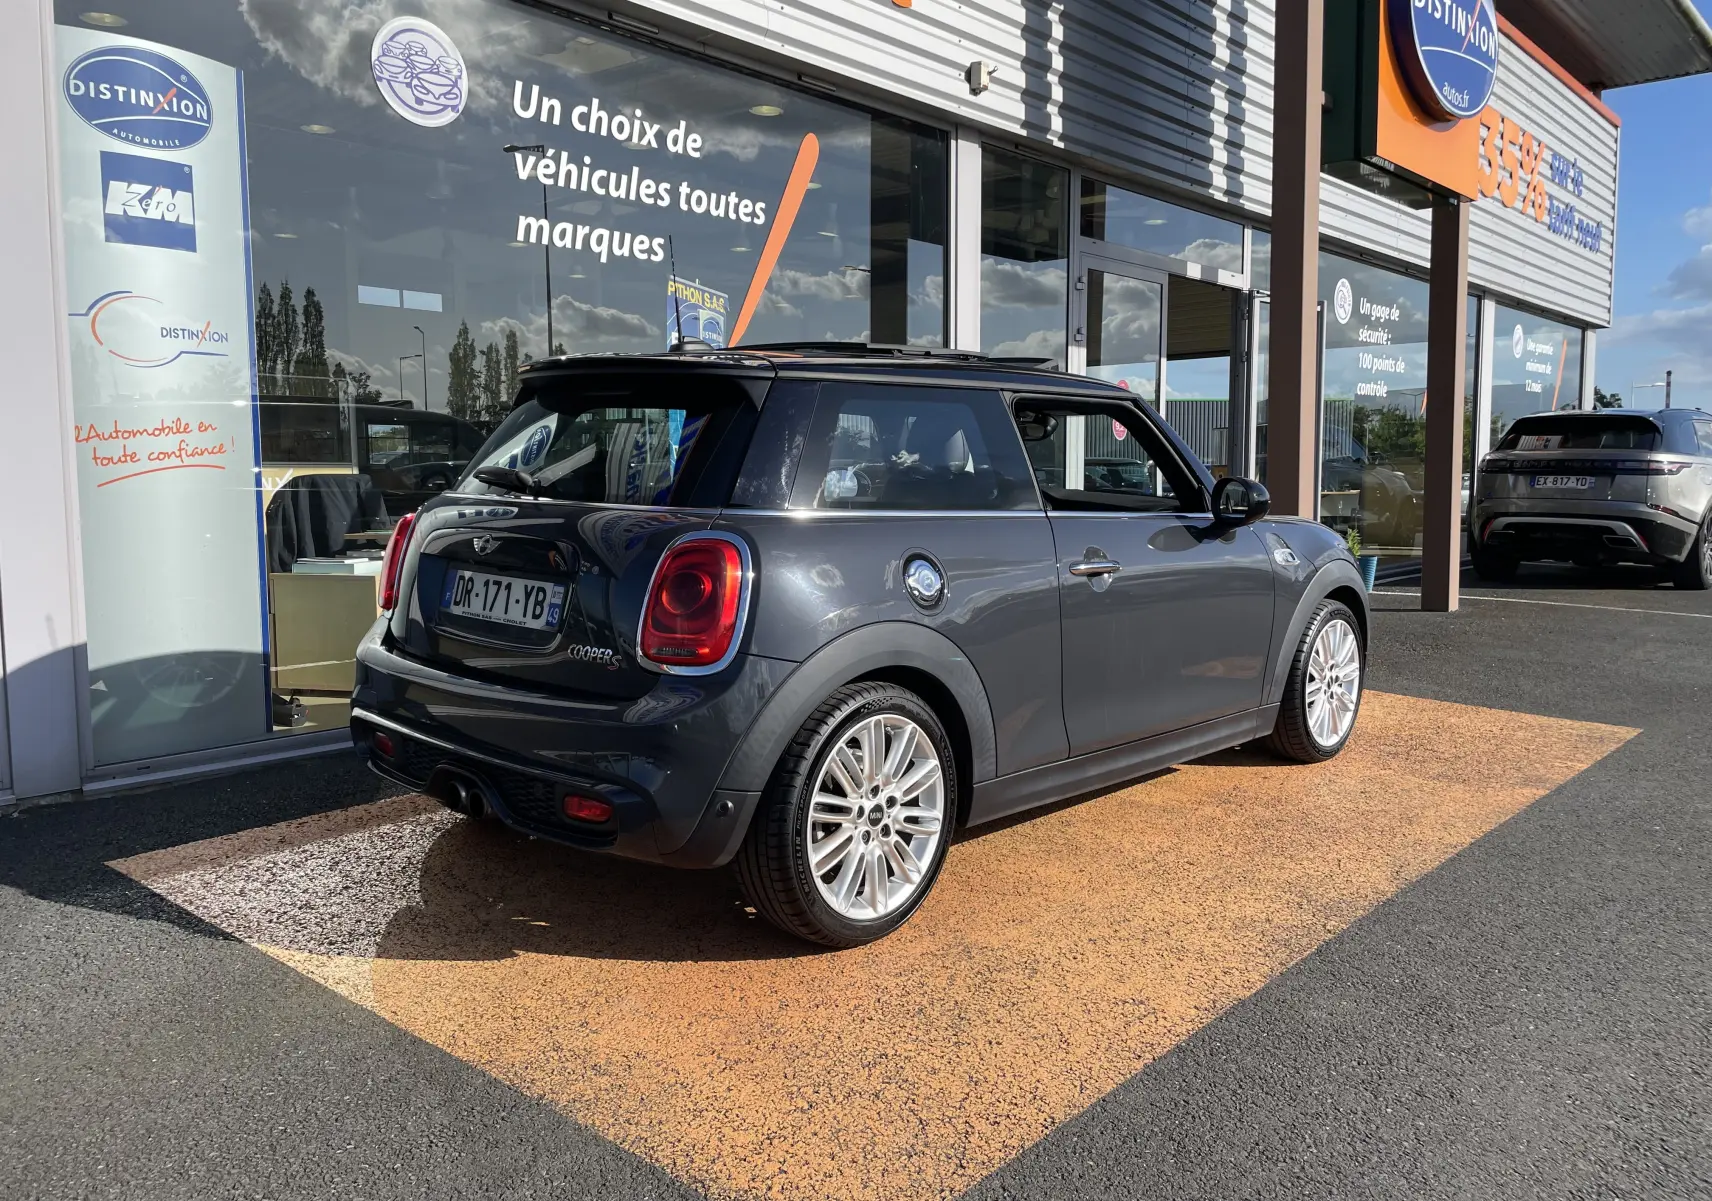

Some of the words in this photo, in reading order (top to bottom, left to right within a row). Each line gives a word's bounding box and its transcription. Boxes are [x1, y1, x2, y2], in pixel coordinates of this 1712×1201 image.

[69, 79, 208, 120] DISTINXION
[1443, 82, 1470, 108] autos.fr
[513, 80, 562, 126] Un
[571, 97, 660, 149] choix
[666, 120, 703, 158] de
[112, 128, 181, 147] AUTOMOBILE
[514, 148, 671, 208] véhicules
[679, 181, 767, 225] toutes
[516, 214, 665, 263] marques
[668, 280, 703, 305] PITHON
[1360, 297, 1371, 315] Un
[1371, 303, 1390, 322] gage
[1390, 304, 1400, 321] de
[160, 321, 229, 347] DISTINXION
[1359, 352, 1373, 369] 100
[1372, 354, 1396, 374] points
[1396, 356, 1405, 373] de
[1357, 380, 1388, 397] contrôle
[198, 420, 217, 432] en
[92, 444, 141, 467] toute
[1535, 476, 1588, 488] EX-817-YD
[452, 575, 548, 621] DR-171-YB
[461, 610, 481, 620] PITHON
[503, 618, 528, 627] CHOLET
[547, 606, 560, 624] 49
[567, 643, 613, 665] COOPER
[607, 655, 623, 671] S
[869, 811, 883, 820] MINI
[795, 836, 810, 893] MICHELIN
